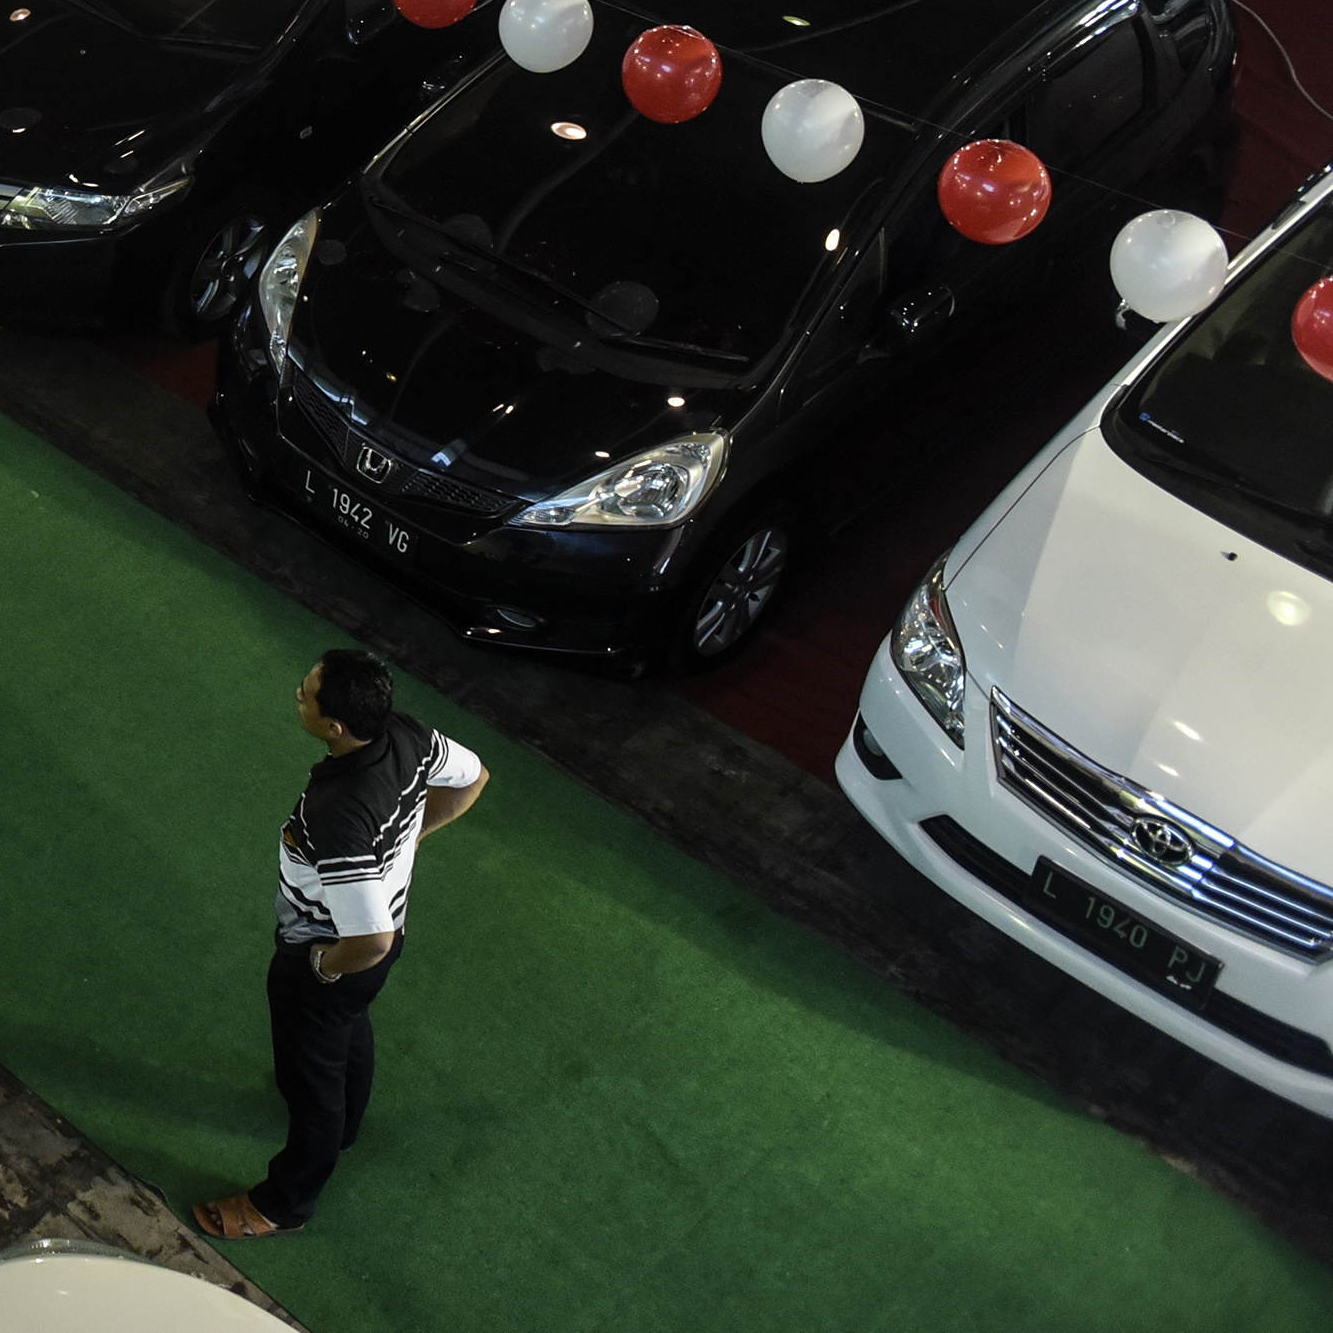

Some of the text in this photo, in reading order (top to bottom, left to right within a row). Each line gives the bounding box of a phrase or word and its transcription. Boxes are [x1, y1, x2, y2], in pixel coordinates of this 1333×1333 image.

[305, 470, 410, 553] L 1942 VG
[1043, 871, 1206, 983] L 1940 PJ
